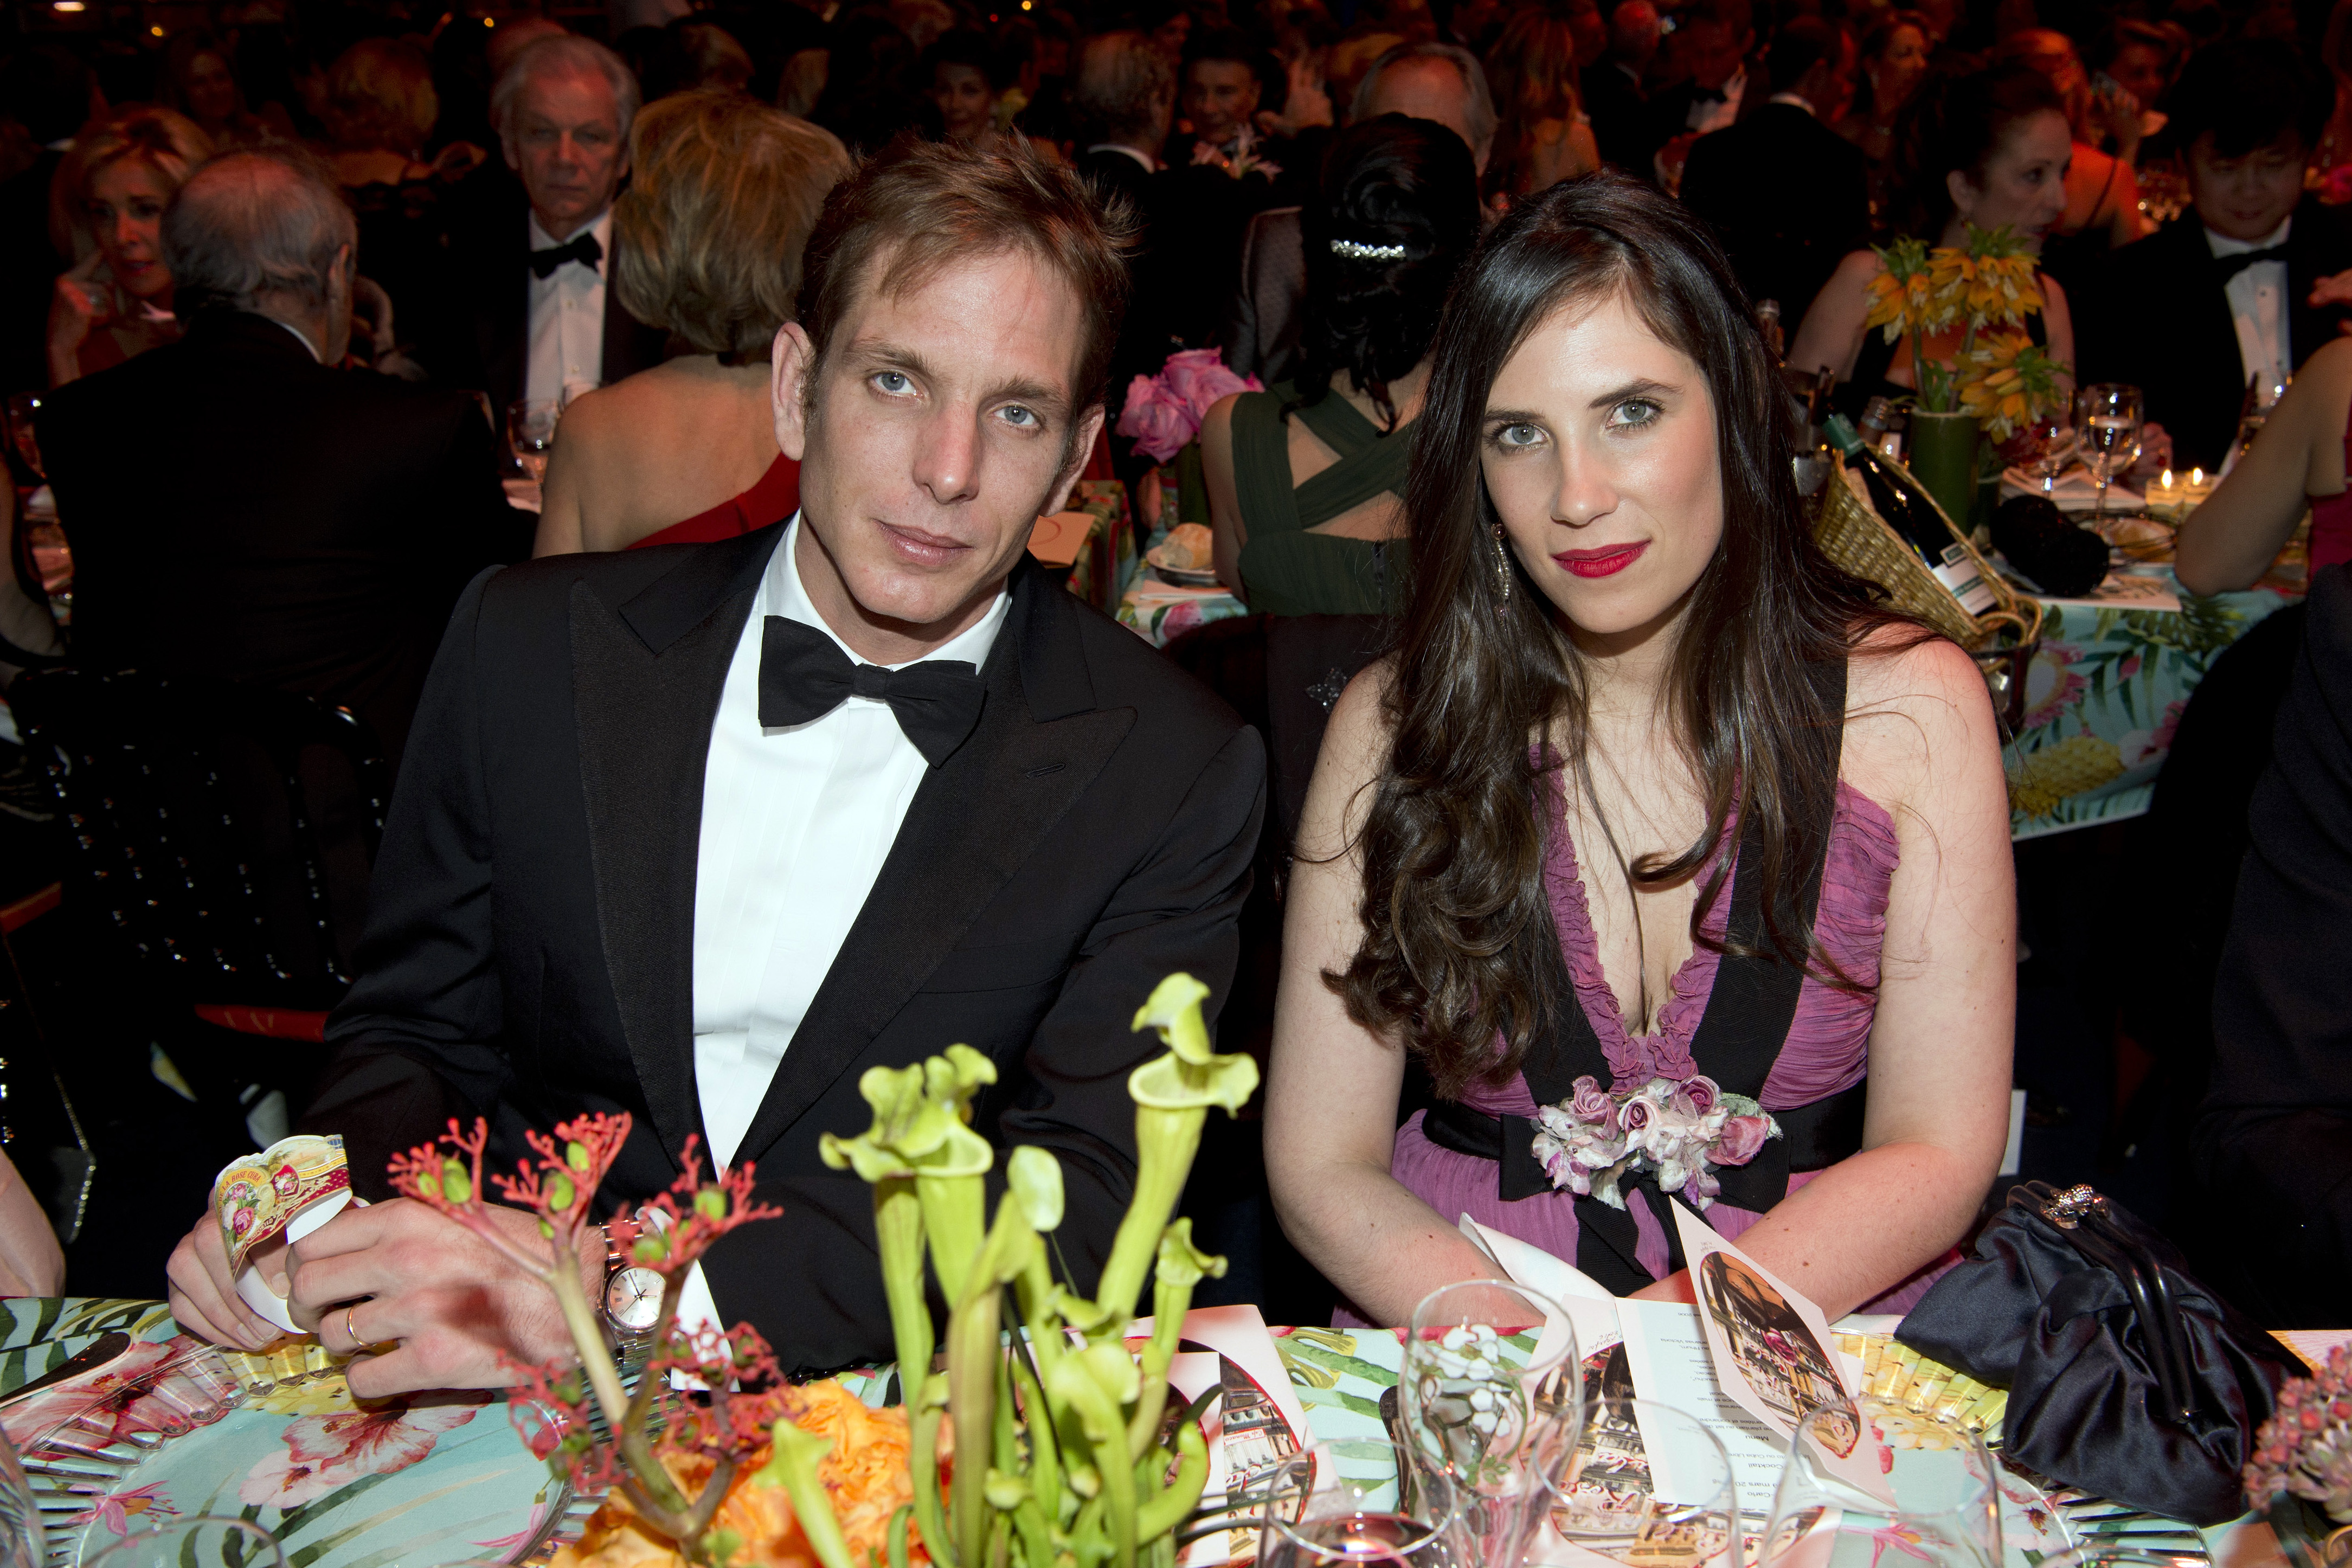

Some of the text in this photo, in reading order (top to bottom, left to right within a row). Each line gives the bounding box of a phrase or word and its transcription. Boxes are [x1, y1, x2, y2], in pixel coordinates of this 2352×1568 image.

[222, 1181, 230, 1191] LA
[232, 1171, 247, 1183] ROSE
[247, 1171, 261, 1183] CUBA
[1225, 1433, 1251, 1442] Monaco
